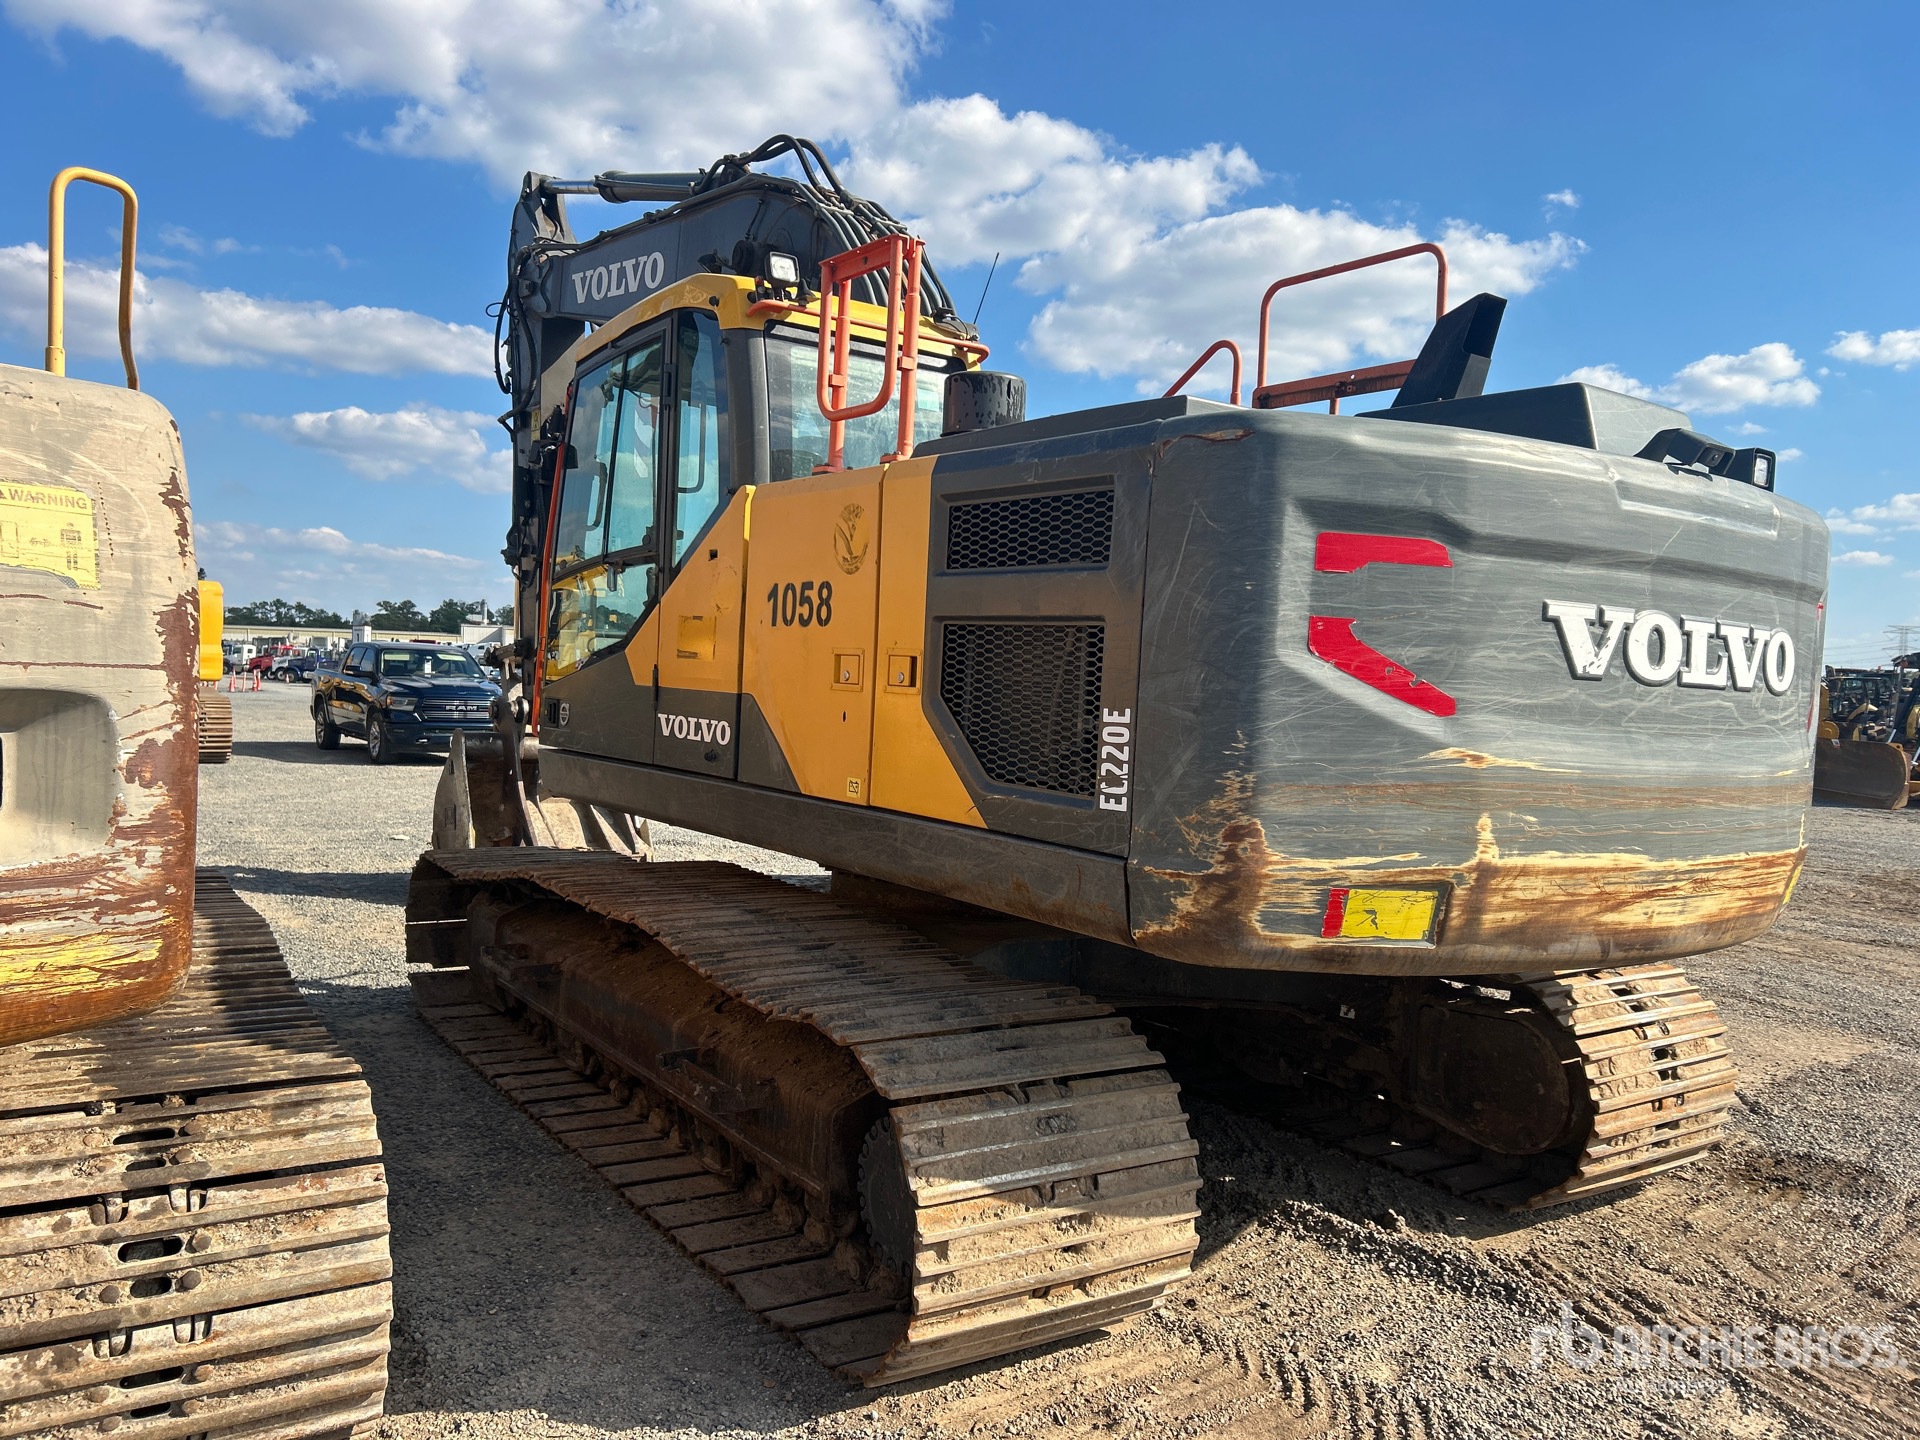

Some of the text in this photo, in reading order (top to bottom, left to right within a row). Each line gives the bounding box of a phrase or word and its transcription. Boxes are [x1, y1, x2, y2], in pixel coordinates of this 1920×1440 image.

[571, 251, 665, 304] VOLVO
[8, 488, 87, 510] WARNING
[767, 580, 832, 627] 1058
[1542, 599, 1795, 697] VOLVO
[657, 713, 731, 746] VOLVO
[1099, 707, 1131, 812] EC220E
